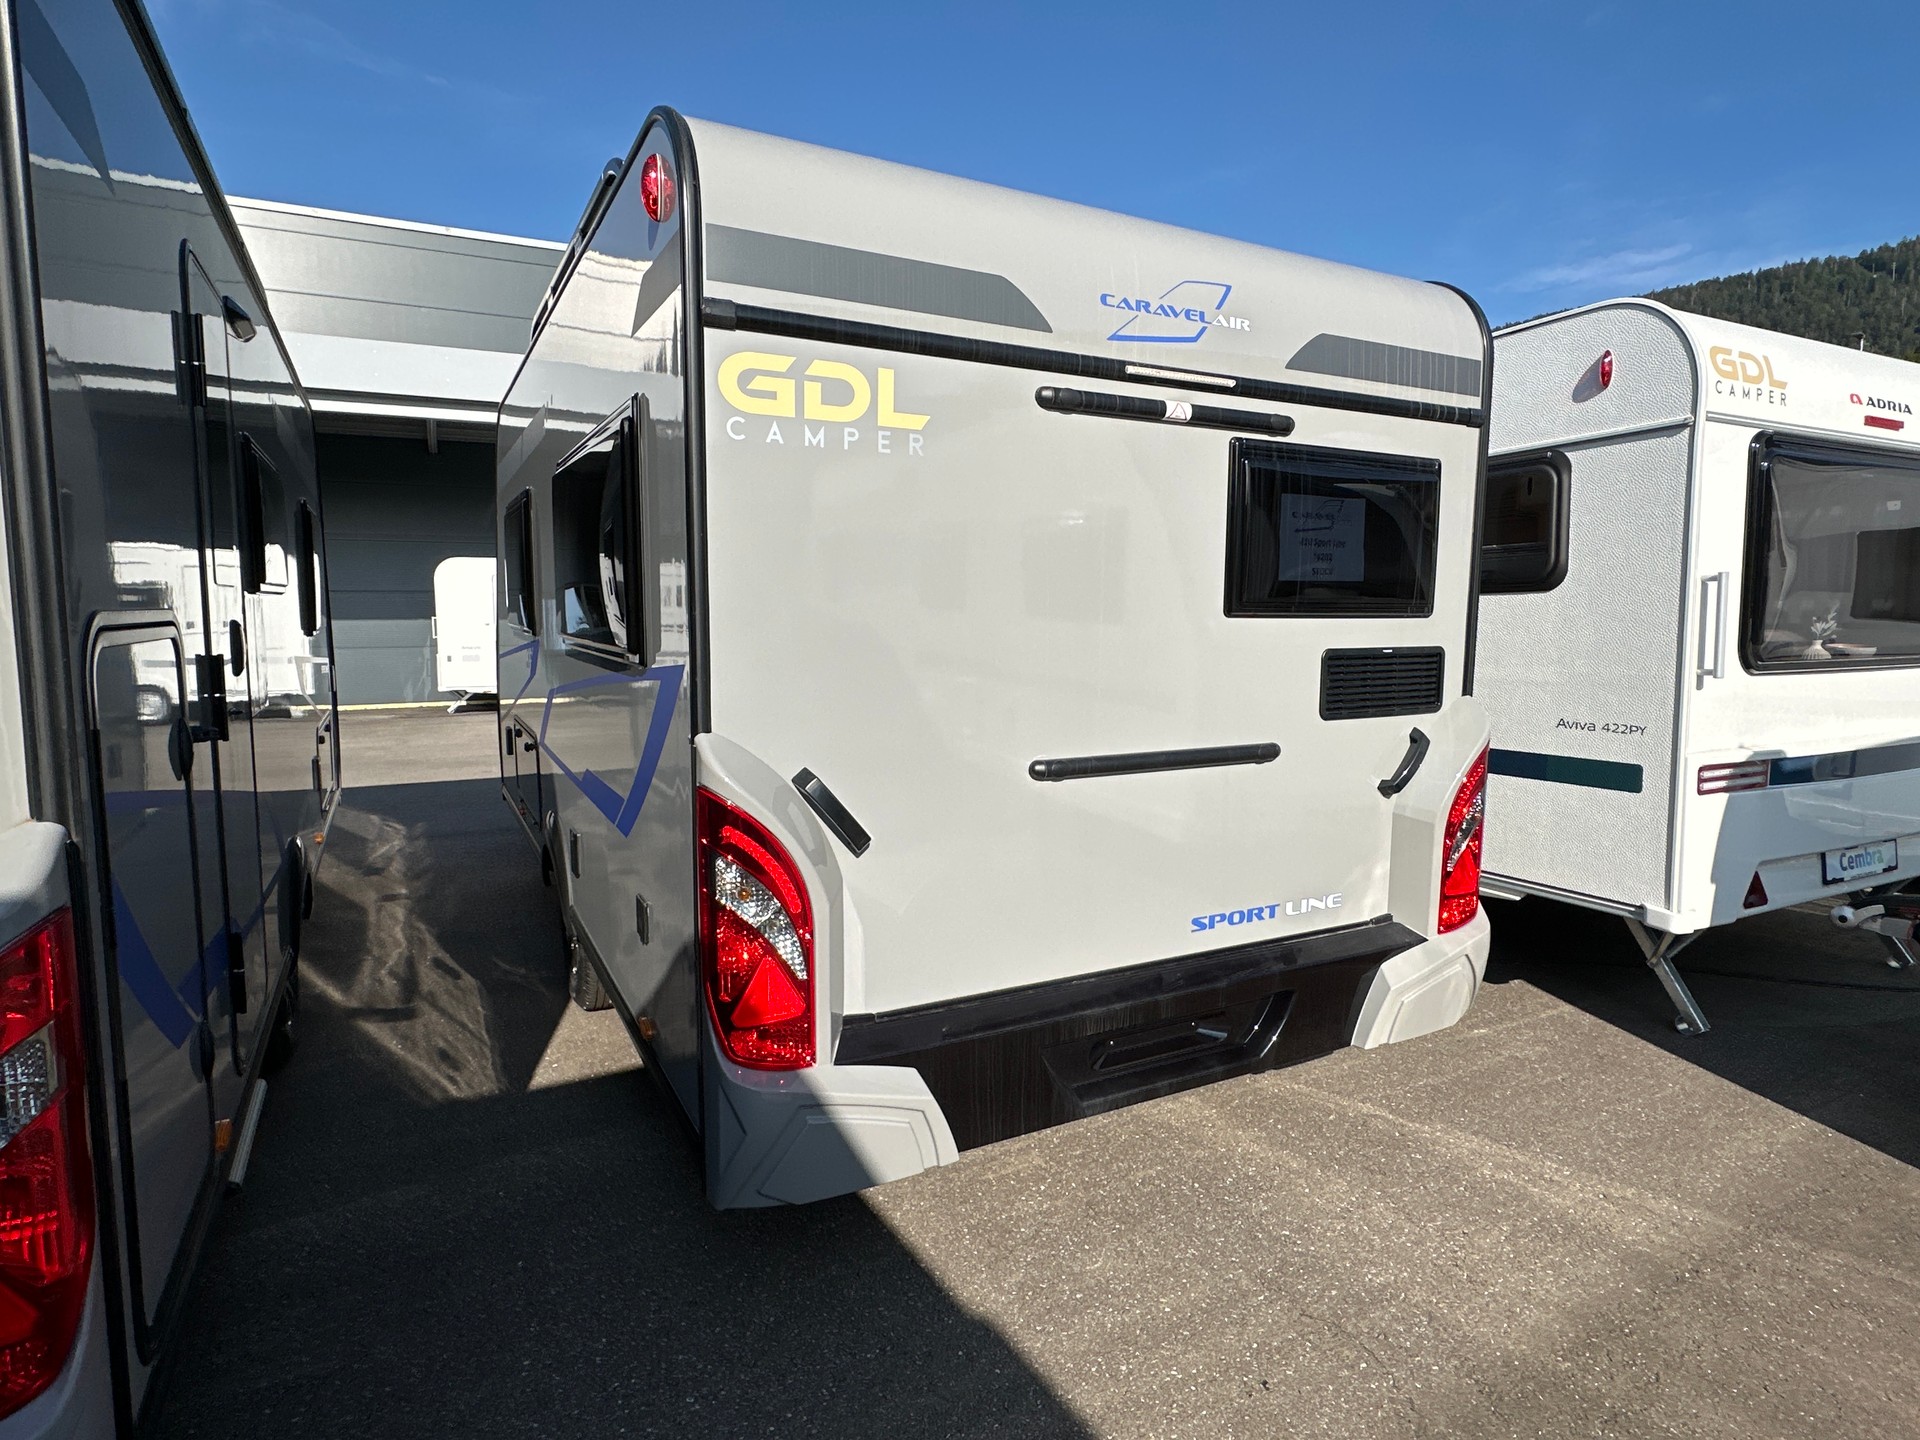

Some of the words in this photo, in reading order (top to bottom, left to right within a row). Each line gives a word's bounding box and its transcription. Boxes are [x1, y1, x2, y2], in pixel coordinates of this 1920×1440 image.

[1100, 293, 1251, 332] CARAVELAIR
[1709, 345, 1788, 390] GDL
[717, 351, 931, 431] GDL
[1714, 379, 1788, 407] CAMPER
[1866, 396, 1913, 415] ADRIA
[725, 416, 925, 457] CAMPER
[1555, 718, 1596, 731] Aviva
[1601, 723, 1647, 736] 422PY
[1840, 846, 1884, 872] Cembra
[1190, 903, 1281, 933] SPORT
[1285, 892, 1343, 916] LINE
